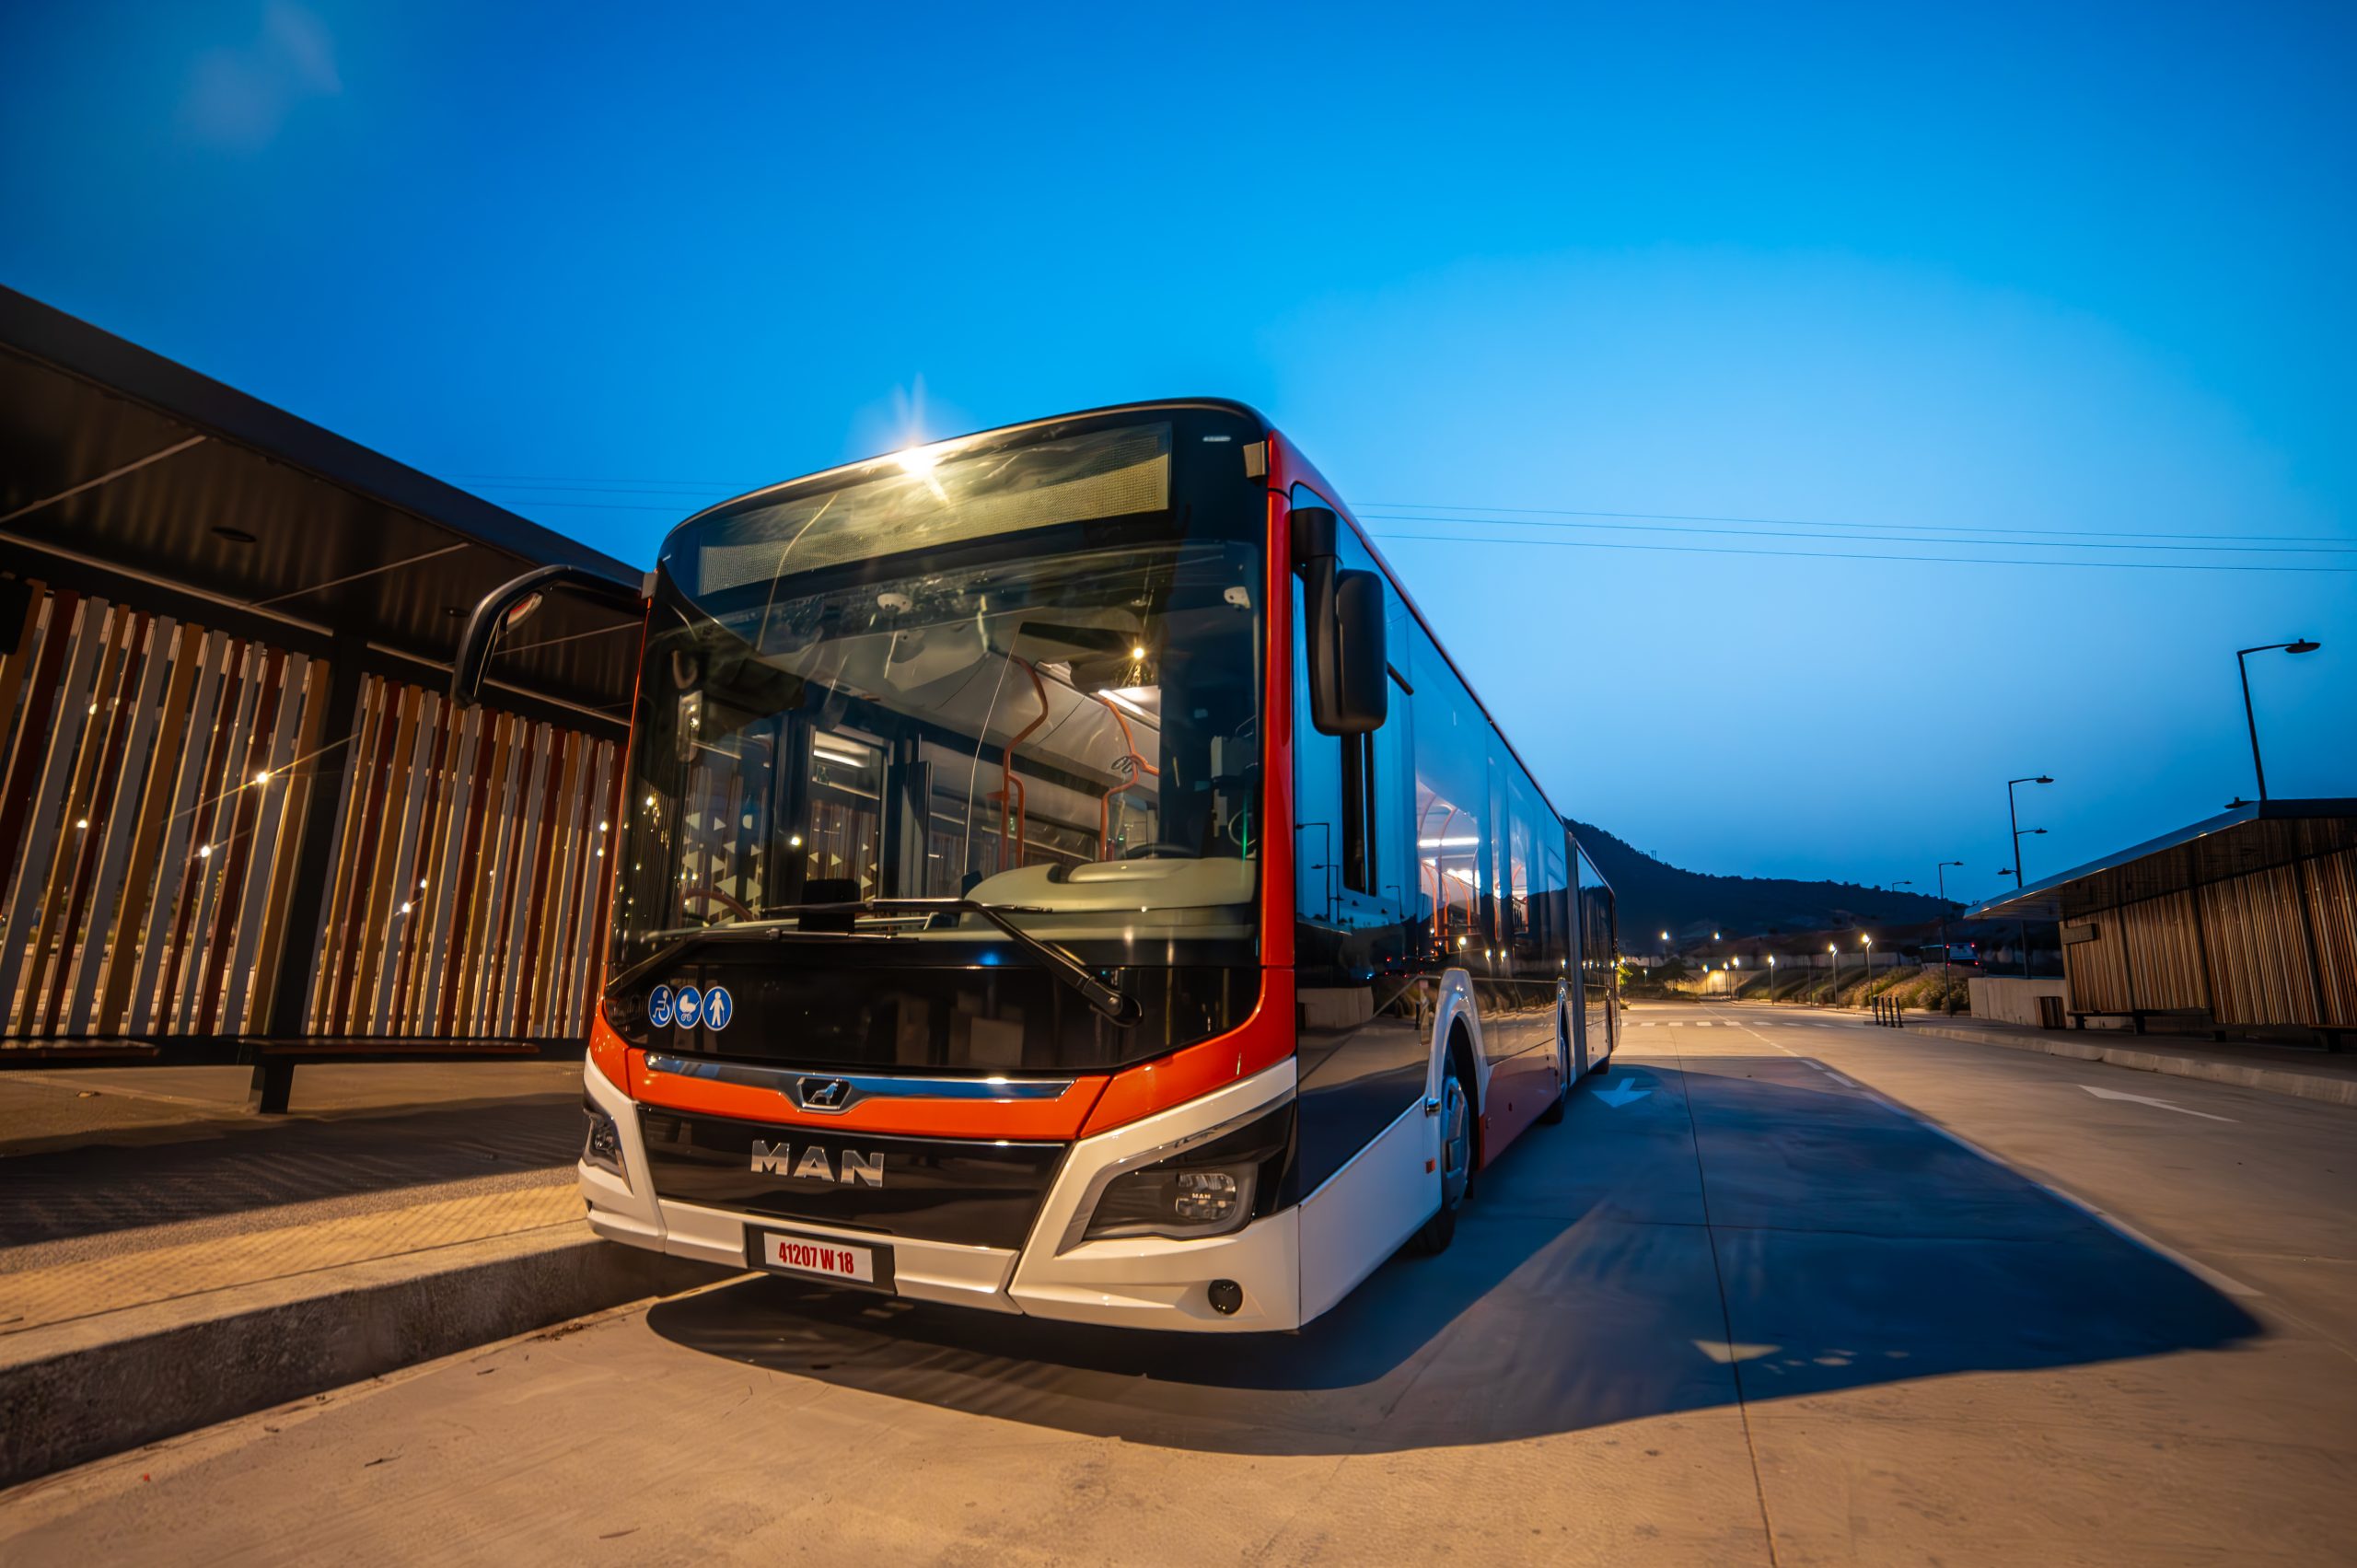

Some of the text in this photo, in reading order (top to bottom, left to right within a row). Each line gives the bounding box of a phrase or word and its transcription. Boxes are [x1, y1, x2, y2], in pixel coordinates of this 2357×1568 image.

[750, 1140, 884, 1188] MAN
[779, 1242, 854, 1274] 41207 W 18
